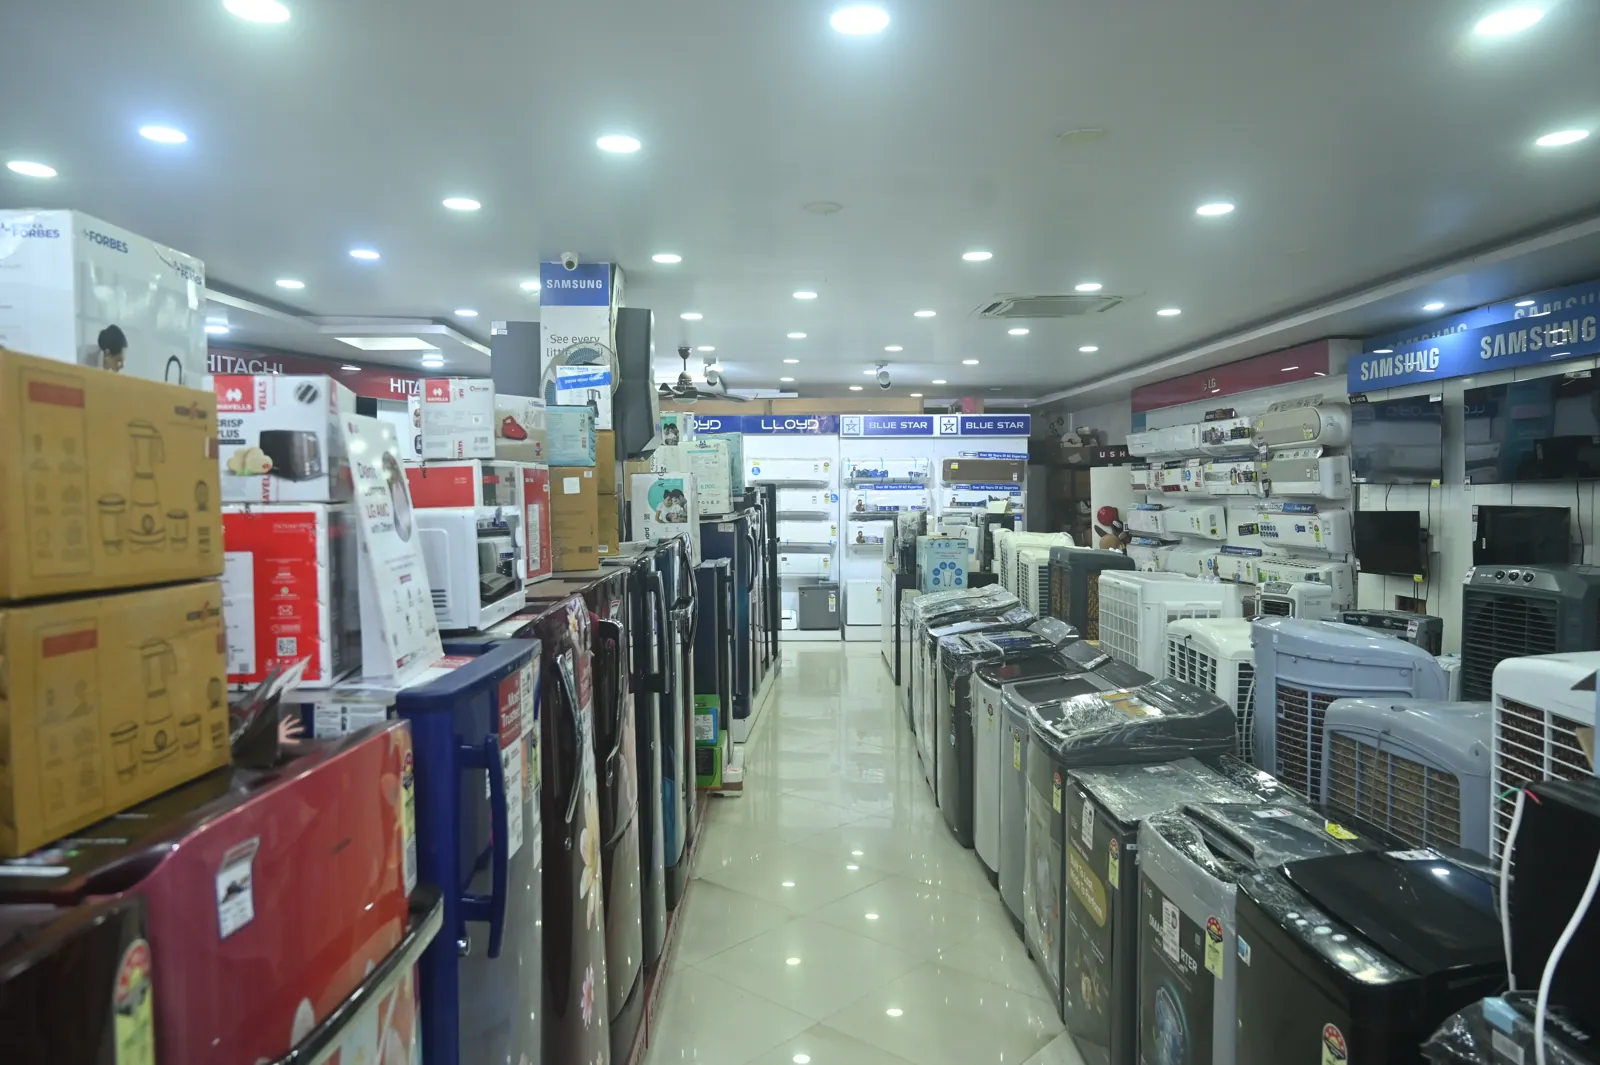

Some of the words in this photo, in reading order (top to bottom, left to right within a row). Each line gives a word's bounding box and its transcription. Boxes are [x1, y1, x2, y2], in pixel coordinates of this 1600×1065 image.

[89, 230, 128, 253] FORBES
[546, 279, 603, 289] SAMSUNG
[550, 334, 569, 344] See
[571, 335, 600, 345] every
[1480, 316, 1597, 360] SAMSUNG
[1361, 347, 1440, 381] SAMSUNG
[761, 419, 819, 430] LLOYD
[869, 421, 897, 429] BLUE
[900, 421, 928, 429] STAR
[965, 421, 994, 429] BLUE
[996, 421, 1024, 429] STAR
